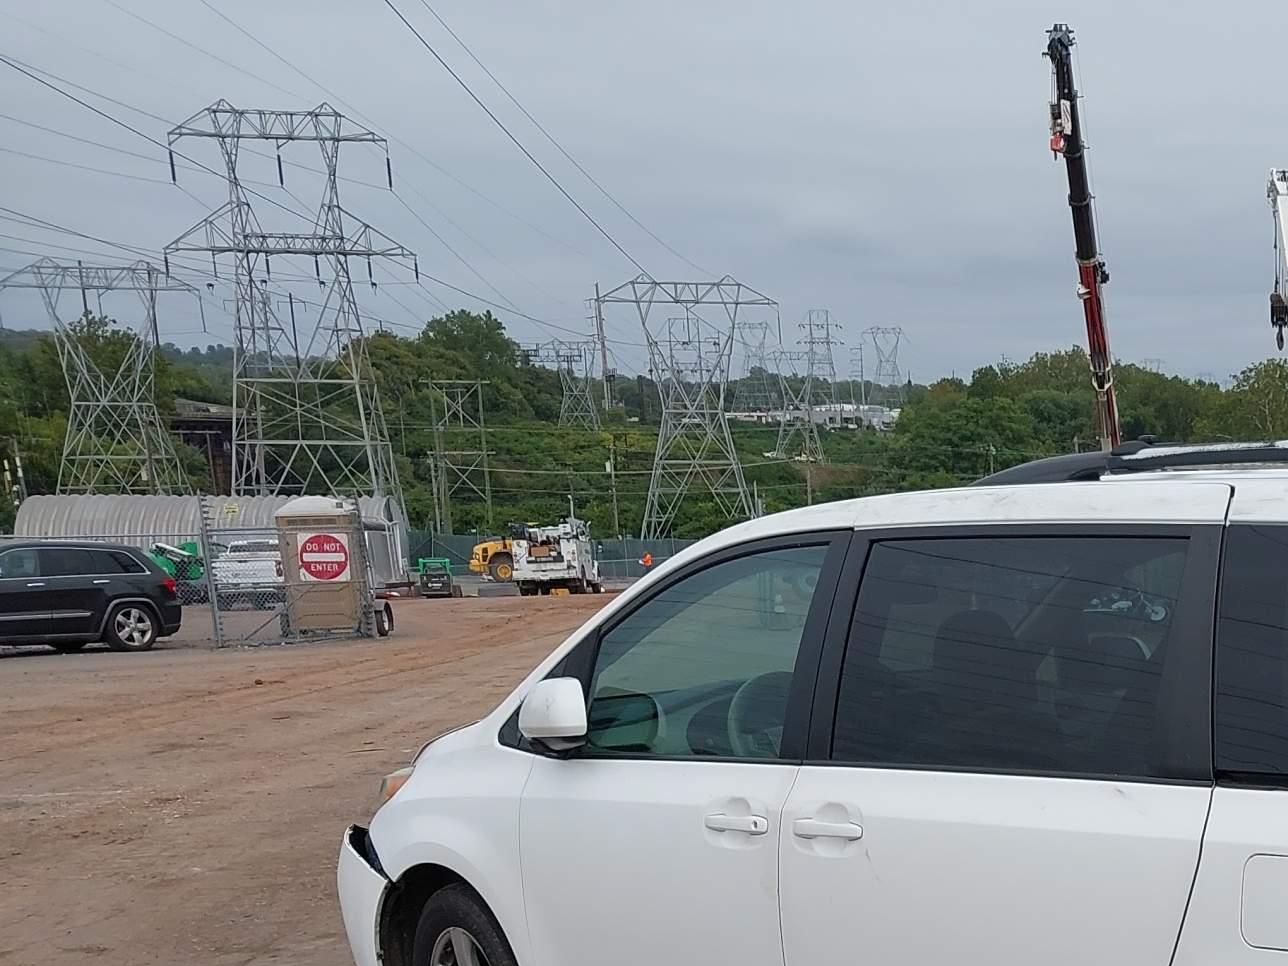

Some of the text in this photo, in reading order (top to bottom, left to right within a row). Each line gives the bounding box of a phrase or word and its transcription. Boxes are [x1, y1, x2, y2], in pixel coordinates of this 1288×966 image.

[306, 542, 341, 552] DO NOT
[310, 563, 338, 572] ENTER
